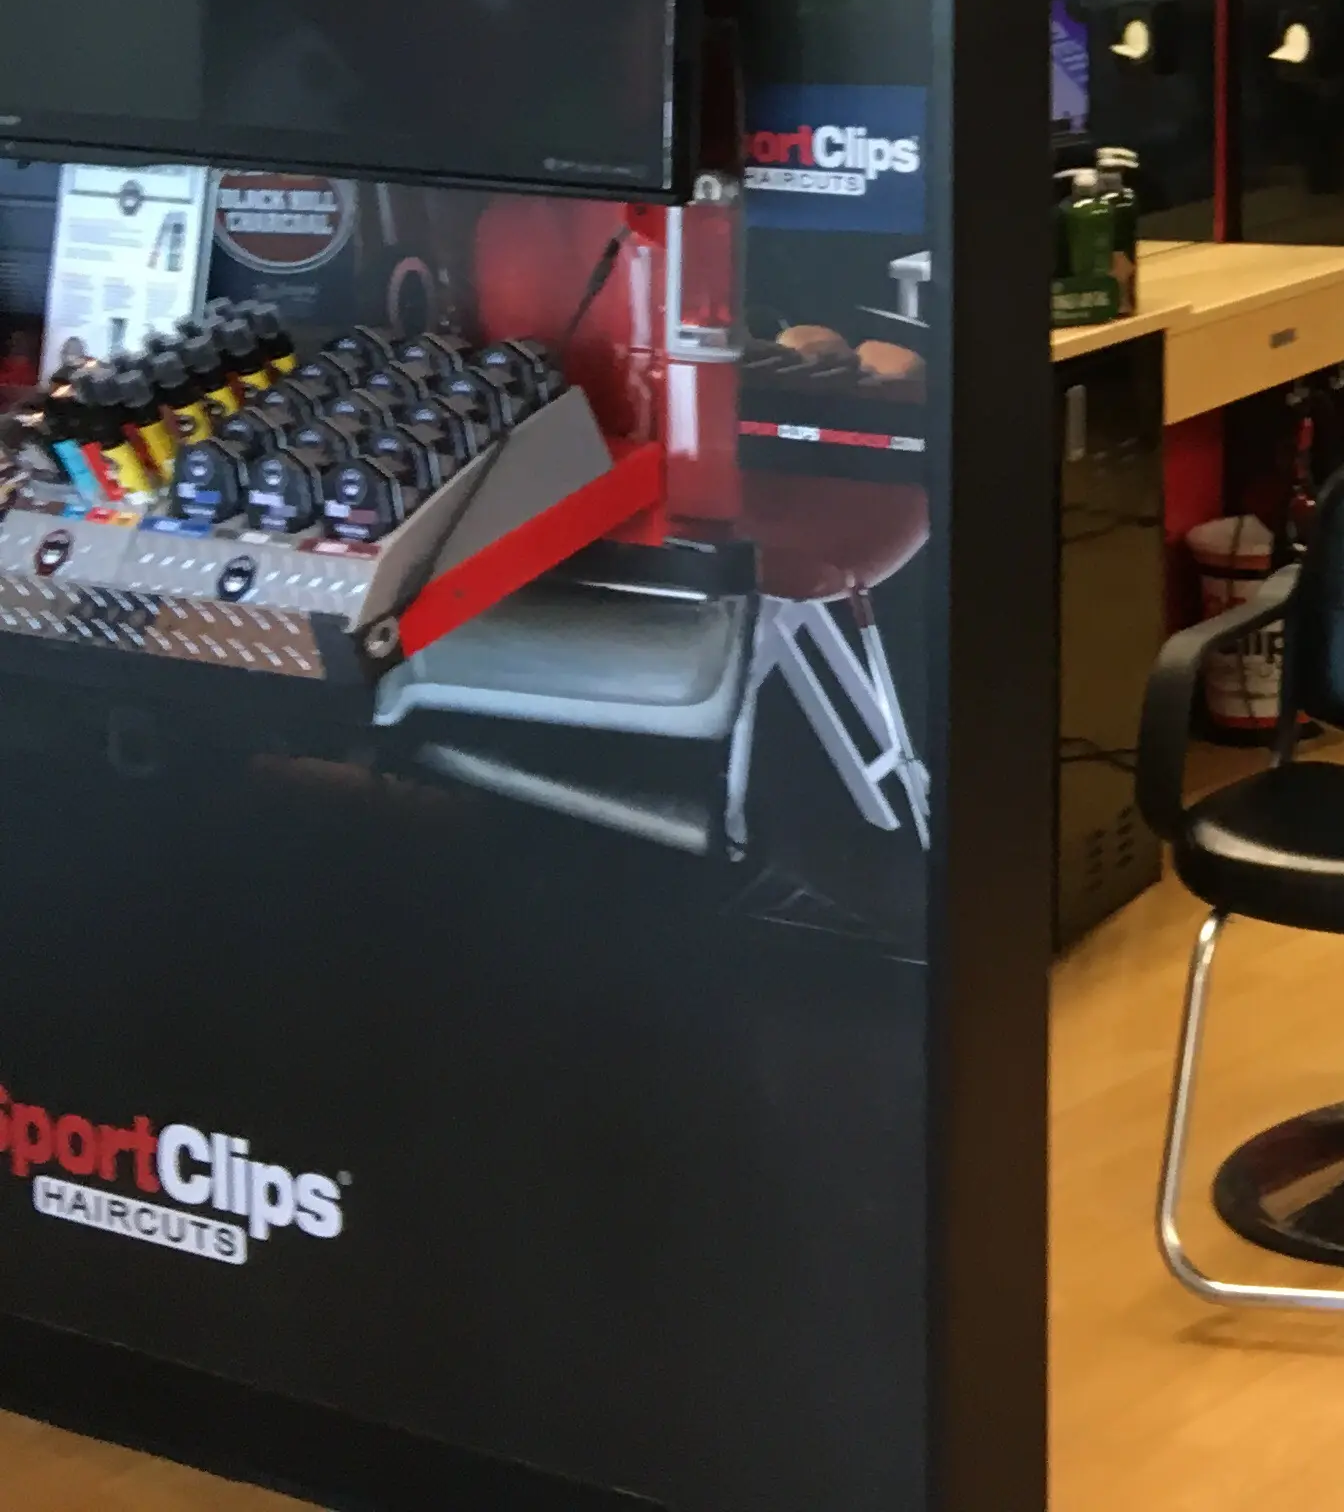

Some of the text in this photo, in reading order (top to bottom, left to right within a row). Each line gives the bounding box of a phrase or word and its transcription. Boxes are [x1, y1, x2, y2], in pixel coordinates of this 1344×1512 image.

[744, 124, 921, 181] ortClips
[0, 1085, 344, 1241] portClips
[40, 1180, 240, 1258] HAIRCUTS
